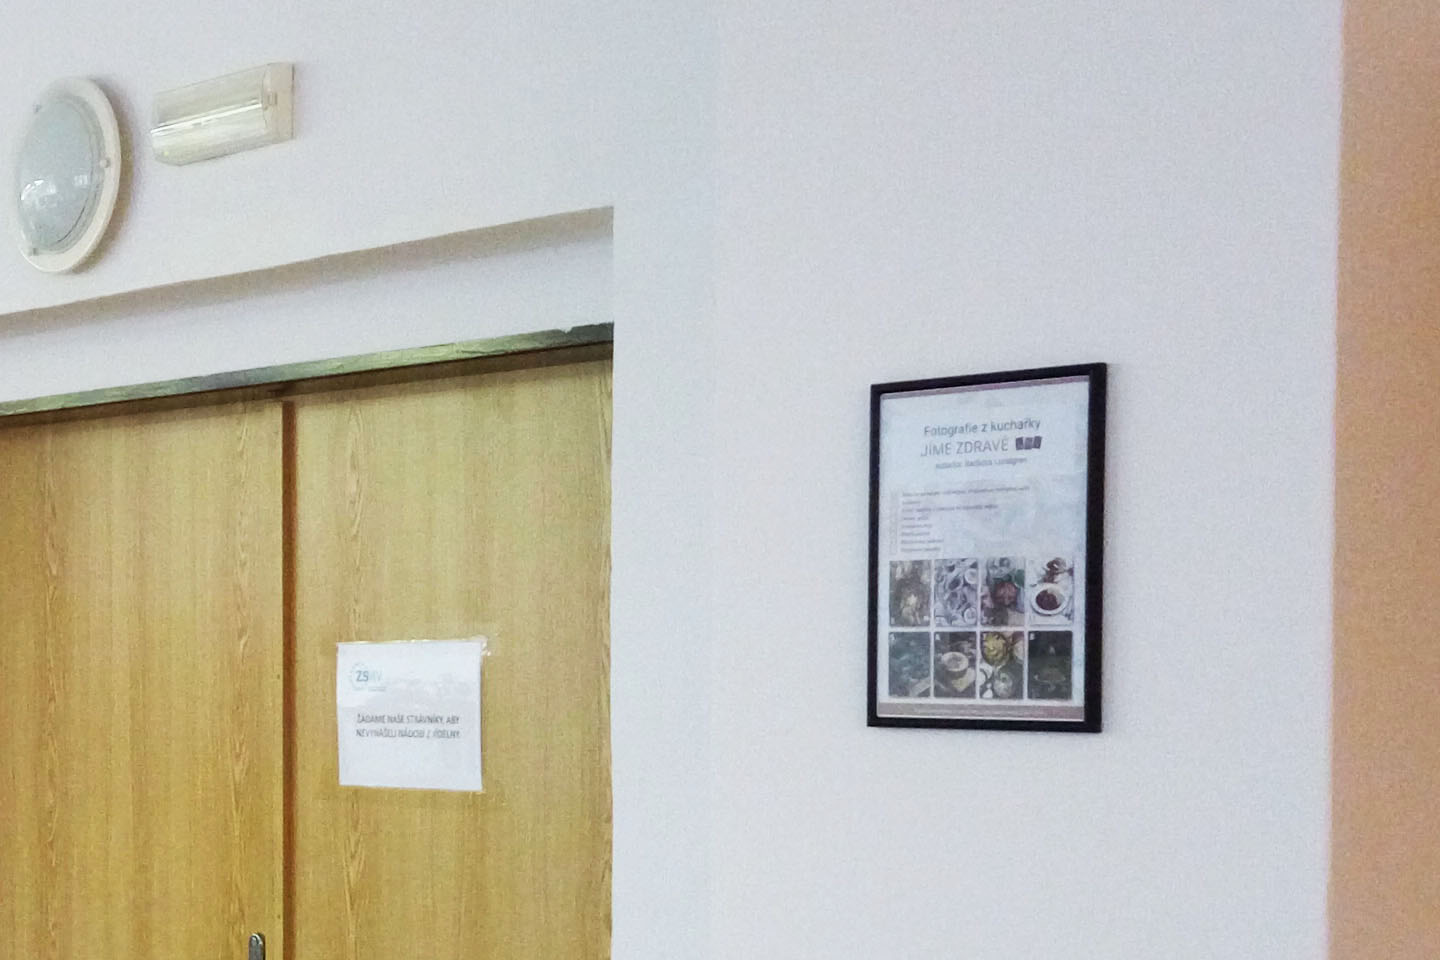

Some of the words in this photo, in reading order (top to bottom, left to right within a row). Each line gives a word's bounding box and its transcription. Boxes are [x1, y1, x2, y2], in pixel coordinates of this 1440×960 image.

[923, 423, 978, 438] Fotografie
[980, 423, 988, 433] z
[920, 441, 952, 457] JÍME
